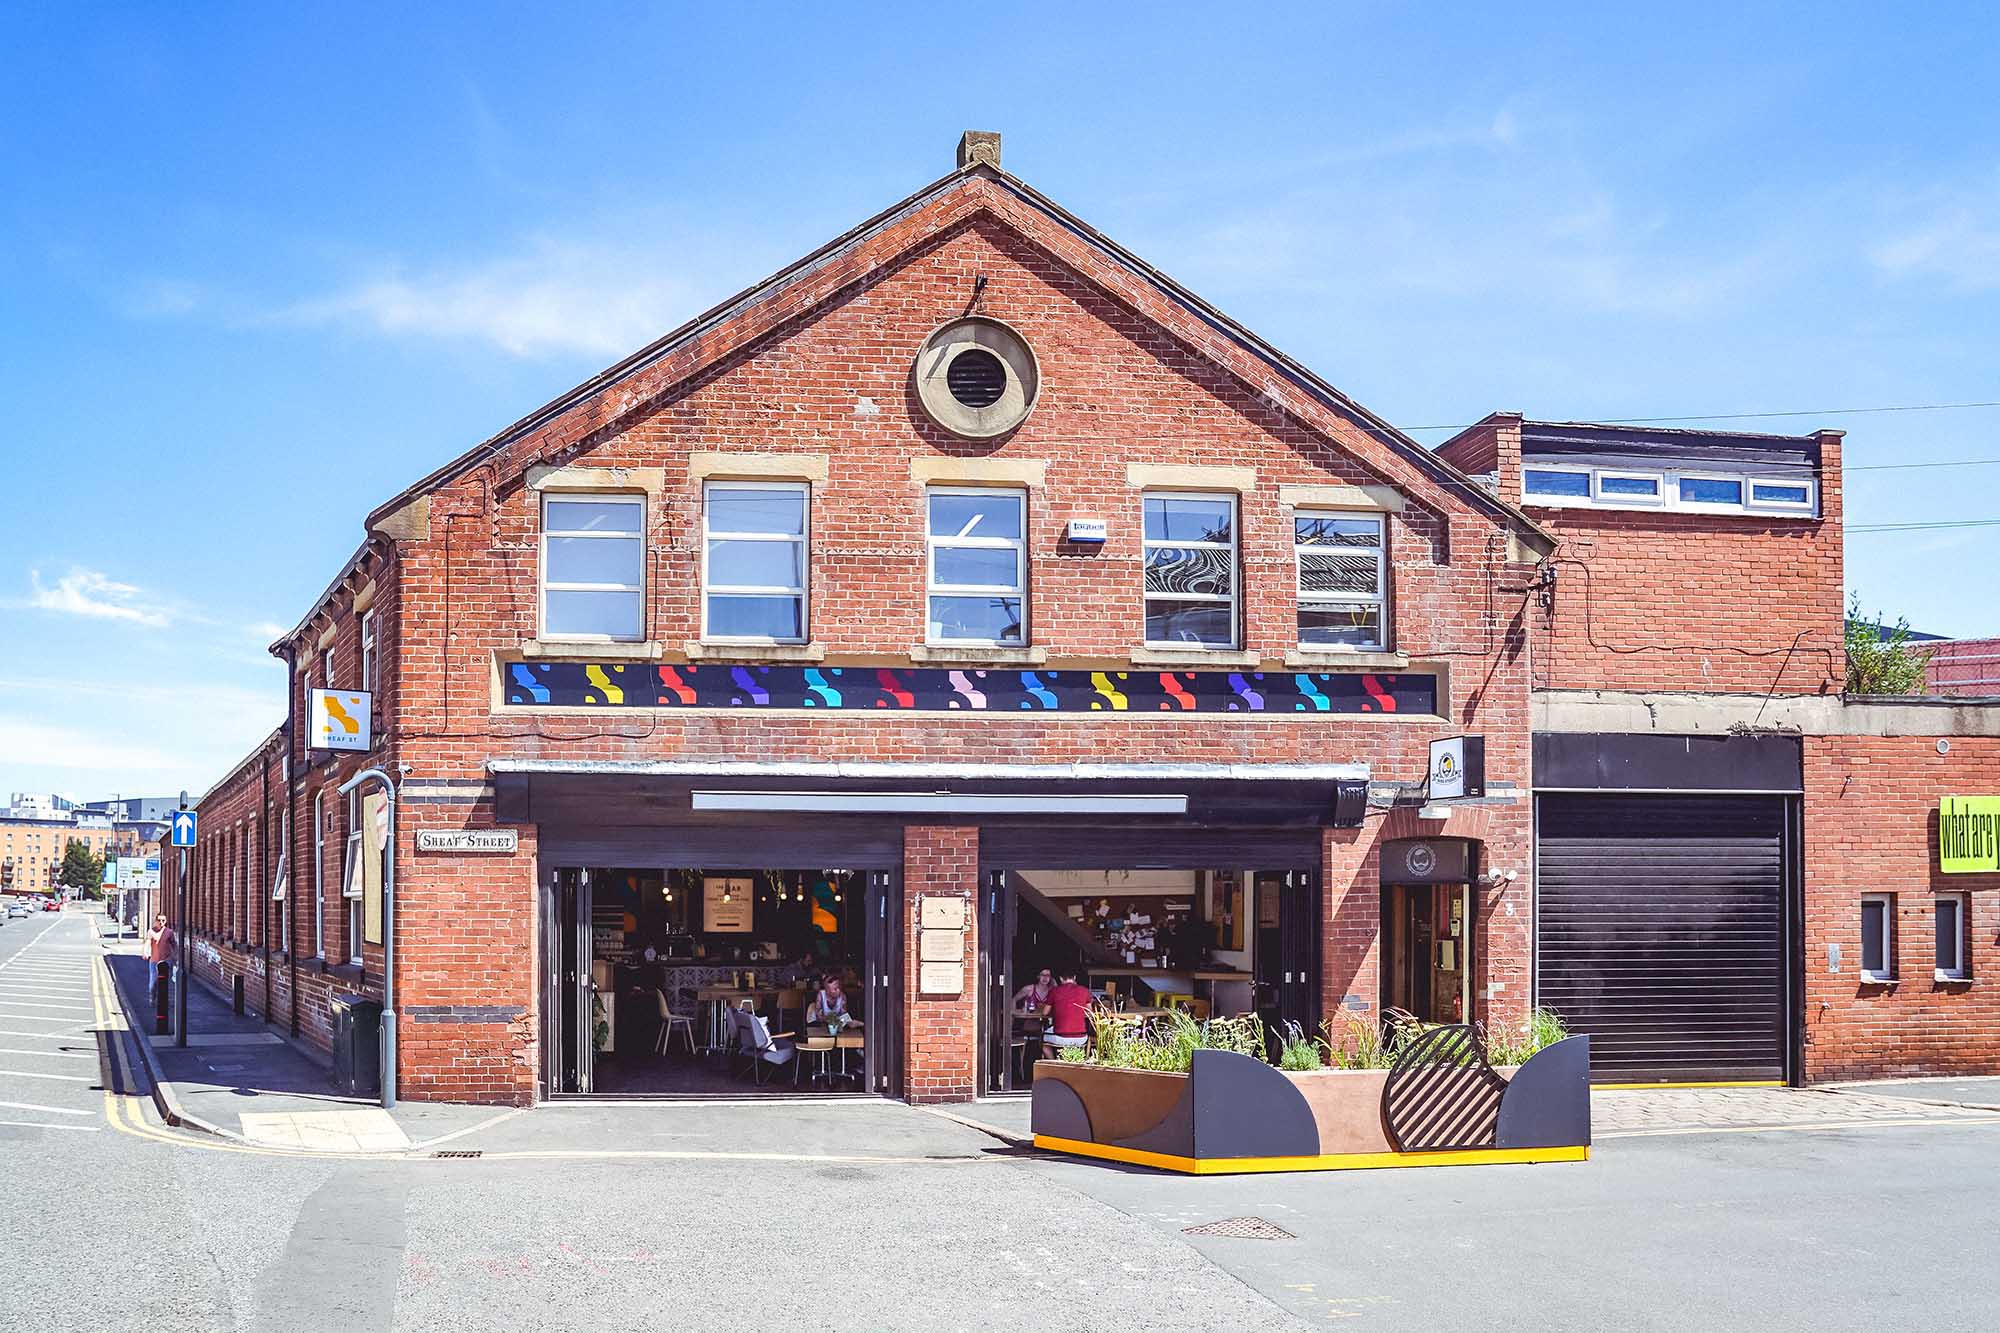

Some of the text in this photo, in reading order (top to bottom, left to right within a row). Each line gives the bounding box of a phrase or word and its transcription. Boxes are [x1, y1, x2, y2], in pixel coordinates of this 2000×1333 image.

[1941, 798, 1970, 859] what
[1972, 814, 1993, 859] are
[423, 835, 511, 847] SHEAF STREET
[1505, 903, 1513, 916] 3
